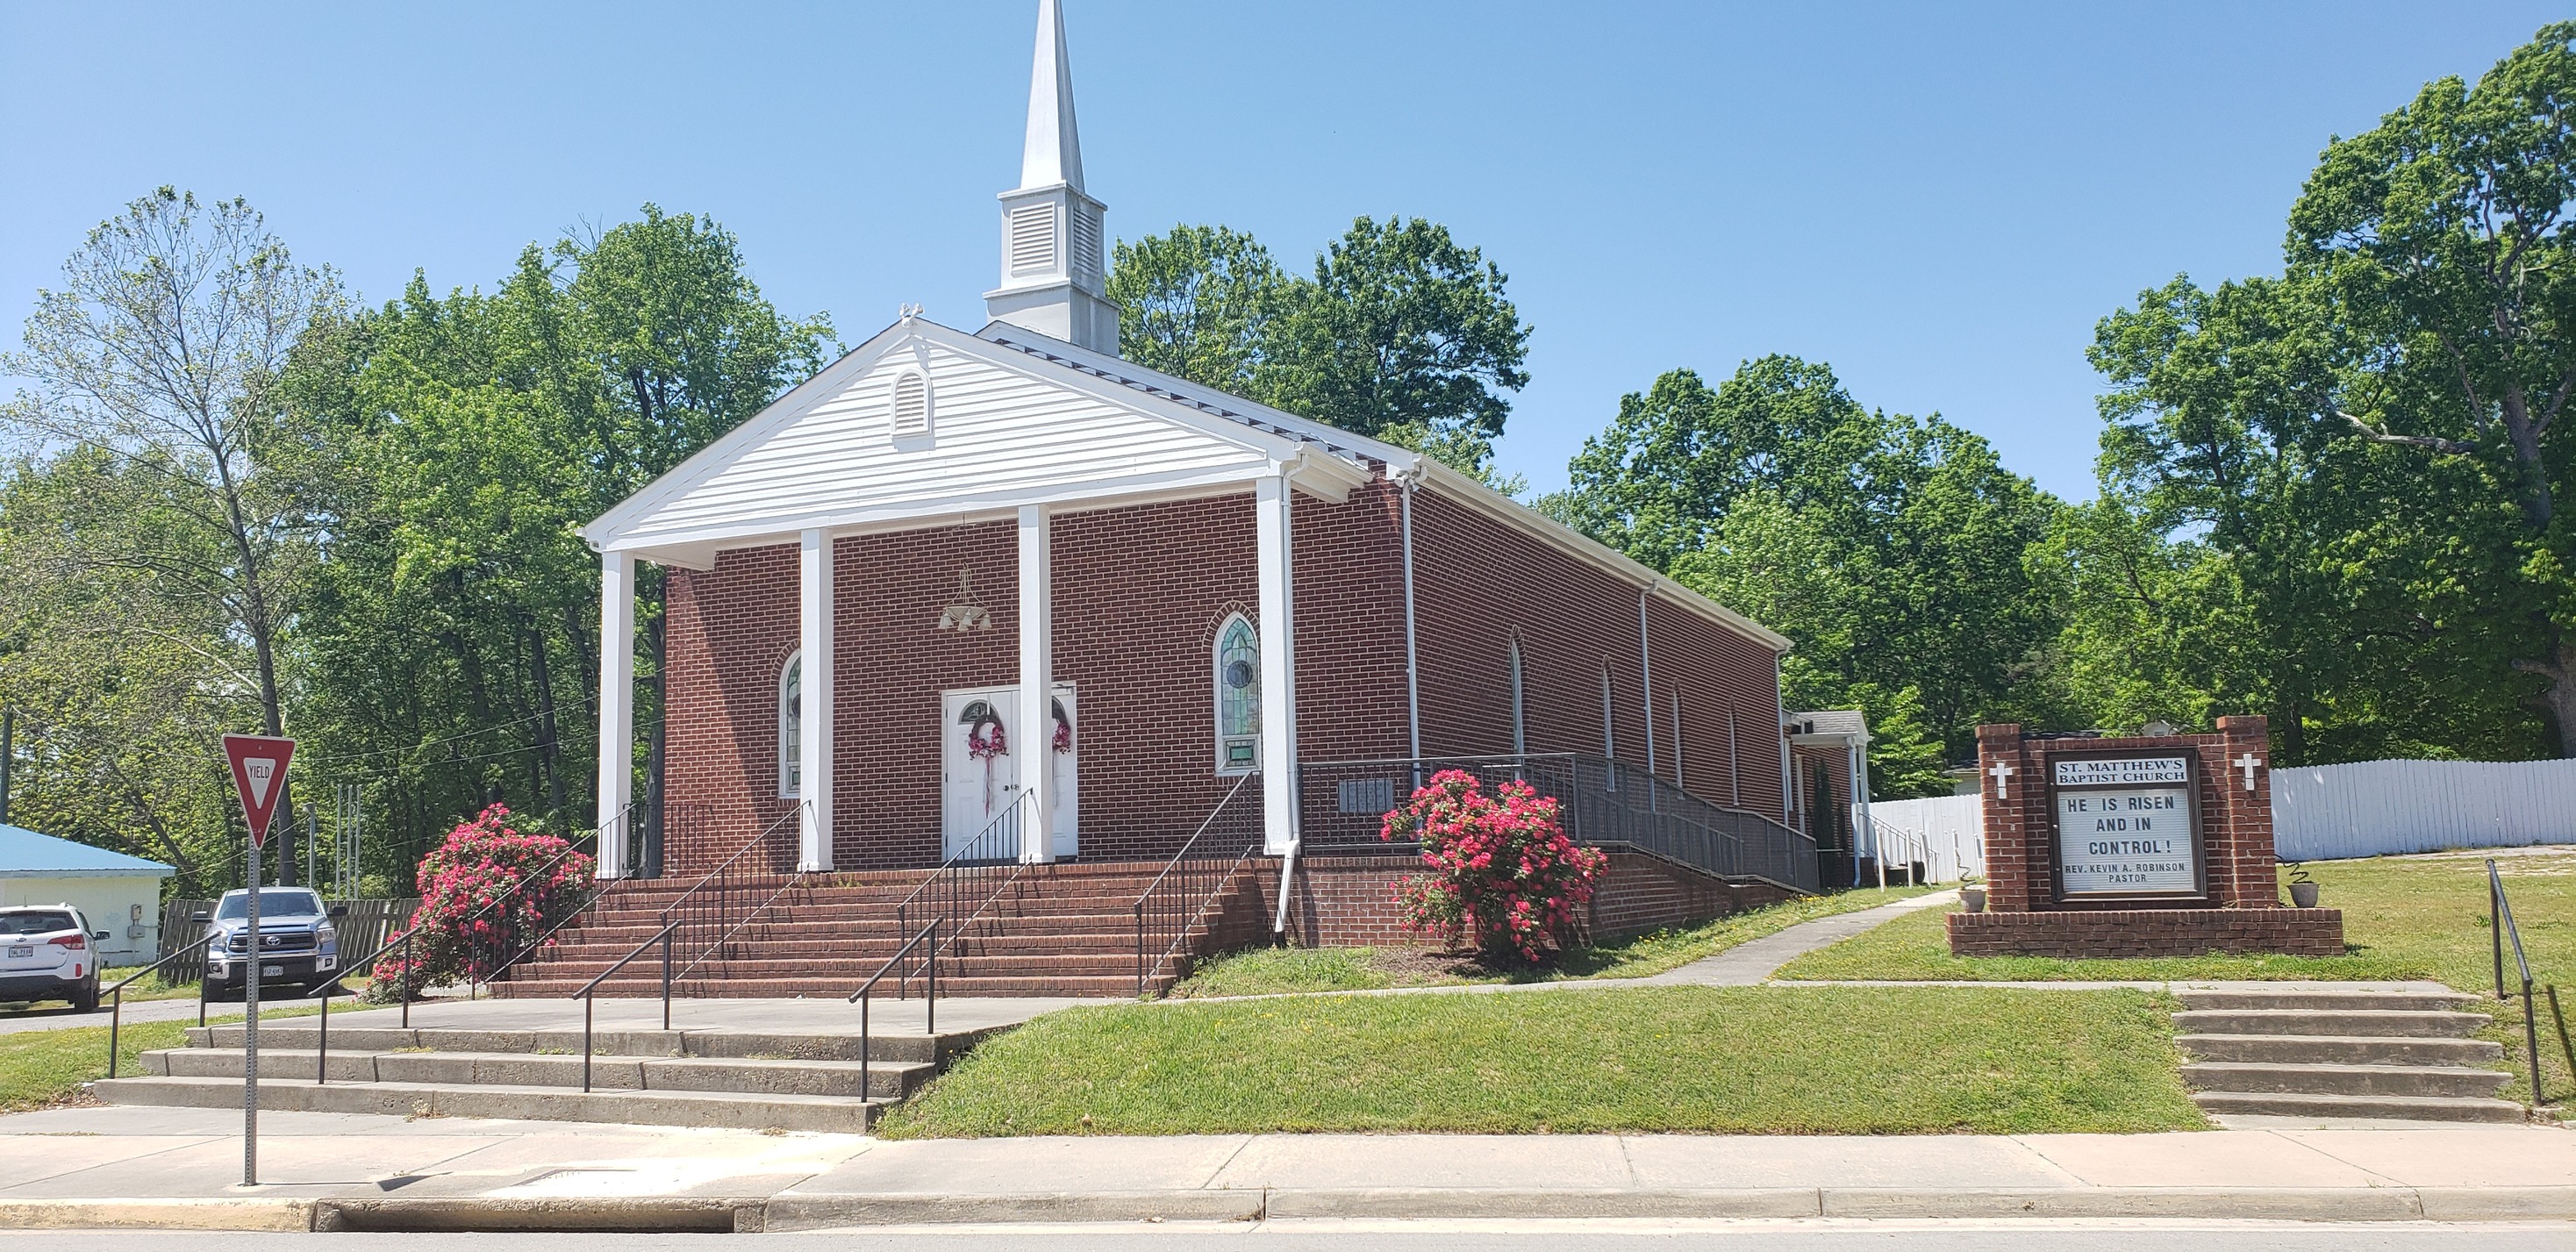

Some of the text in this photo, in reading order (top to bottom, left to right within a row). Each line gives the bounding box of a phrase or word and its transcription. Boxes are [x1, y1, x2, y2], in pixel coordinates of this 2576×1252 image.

[249, 765, 269, 778] YIELD
[2087, 760, 2182, 771] MATTHEW'S
[2123, 772, 2185, 781] CHURCH
[2068, 797, 2174, 812] HE IS RISEN
[2097, 818, 2151, 832] AND IN
